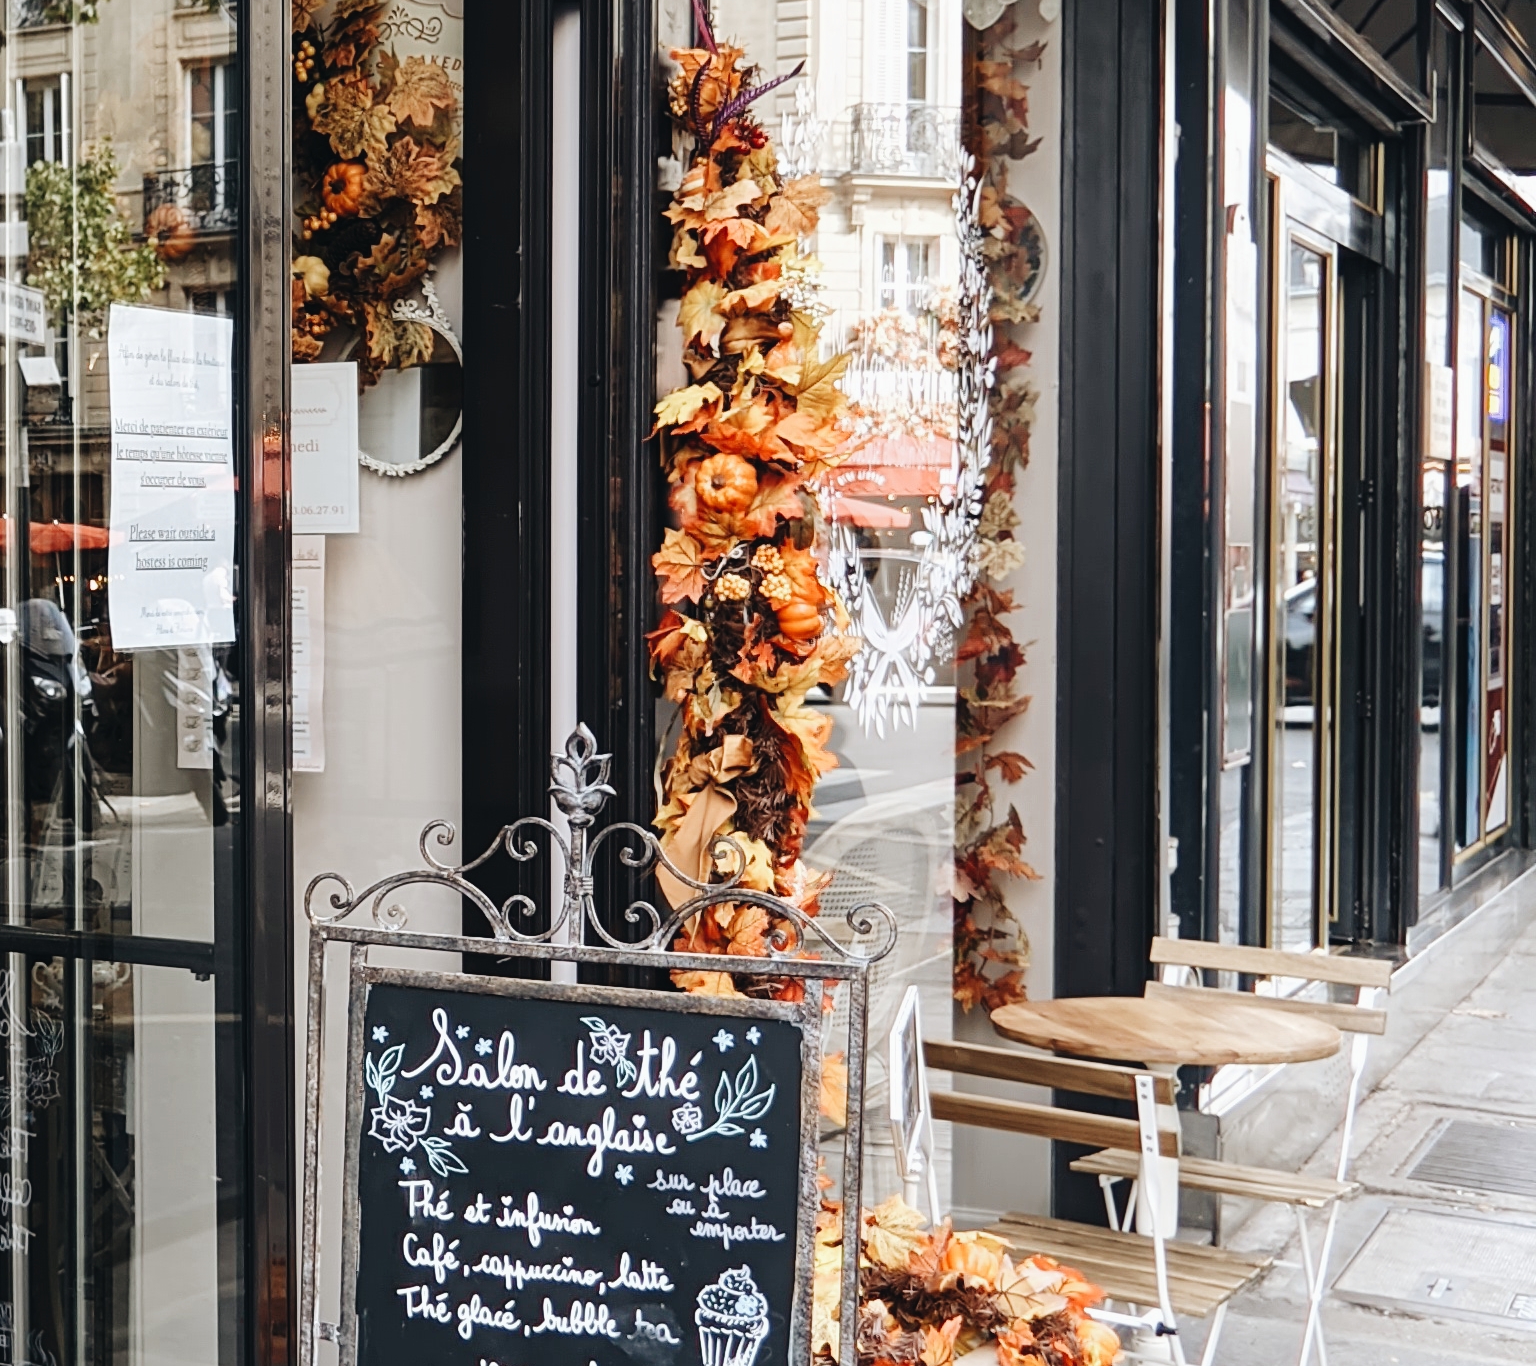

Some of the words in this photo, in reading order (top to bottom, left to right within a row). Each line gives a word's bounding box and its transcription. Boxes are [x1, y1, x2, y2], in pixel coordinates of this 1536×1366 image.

[115, 418, 138, 433] Merci
[139, 418, 149, 433] de
[129, 523, 156, 541] Please
[157, 526, 177, 540] wait
[178, 524, 209, 540] outside
[136, 552, 166, 569] hostess
[177, 553, 208, 572] coming
[402, 1008, 548, 1092] Salon
[557, 1039, 608, 1098] de
[622, 1030, 704, 1100] thé
[647, 1169, 696, 1193] sur
[700, 1166, 767, 1201] place
[398, 1180, 455, 1221] Thé
[464, 1193, 492, 1224] et
[496, 1191, 601, 1248] infusion
[666, 1197, 696, 1217] ou
[690, 1217, 786, 1251] emporter
[610, 1252, 674, 1293] latte
[397, 1287, 453, 1323] Thé
[532, 1297, 621, 1338] bubble
[626, 1311, 680, 1344] tea
